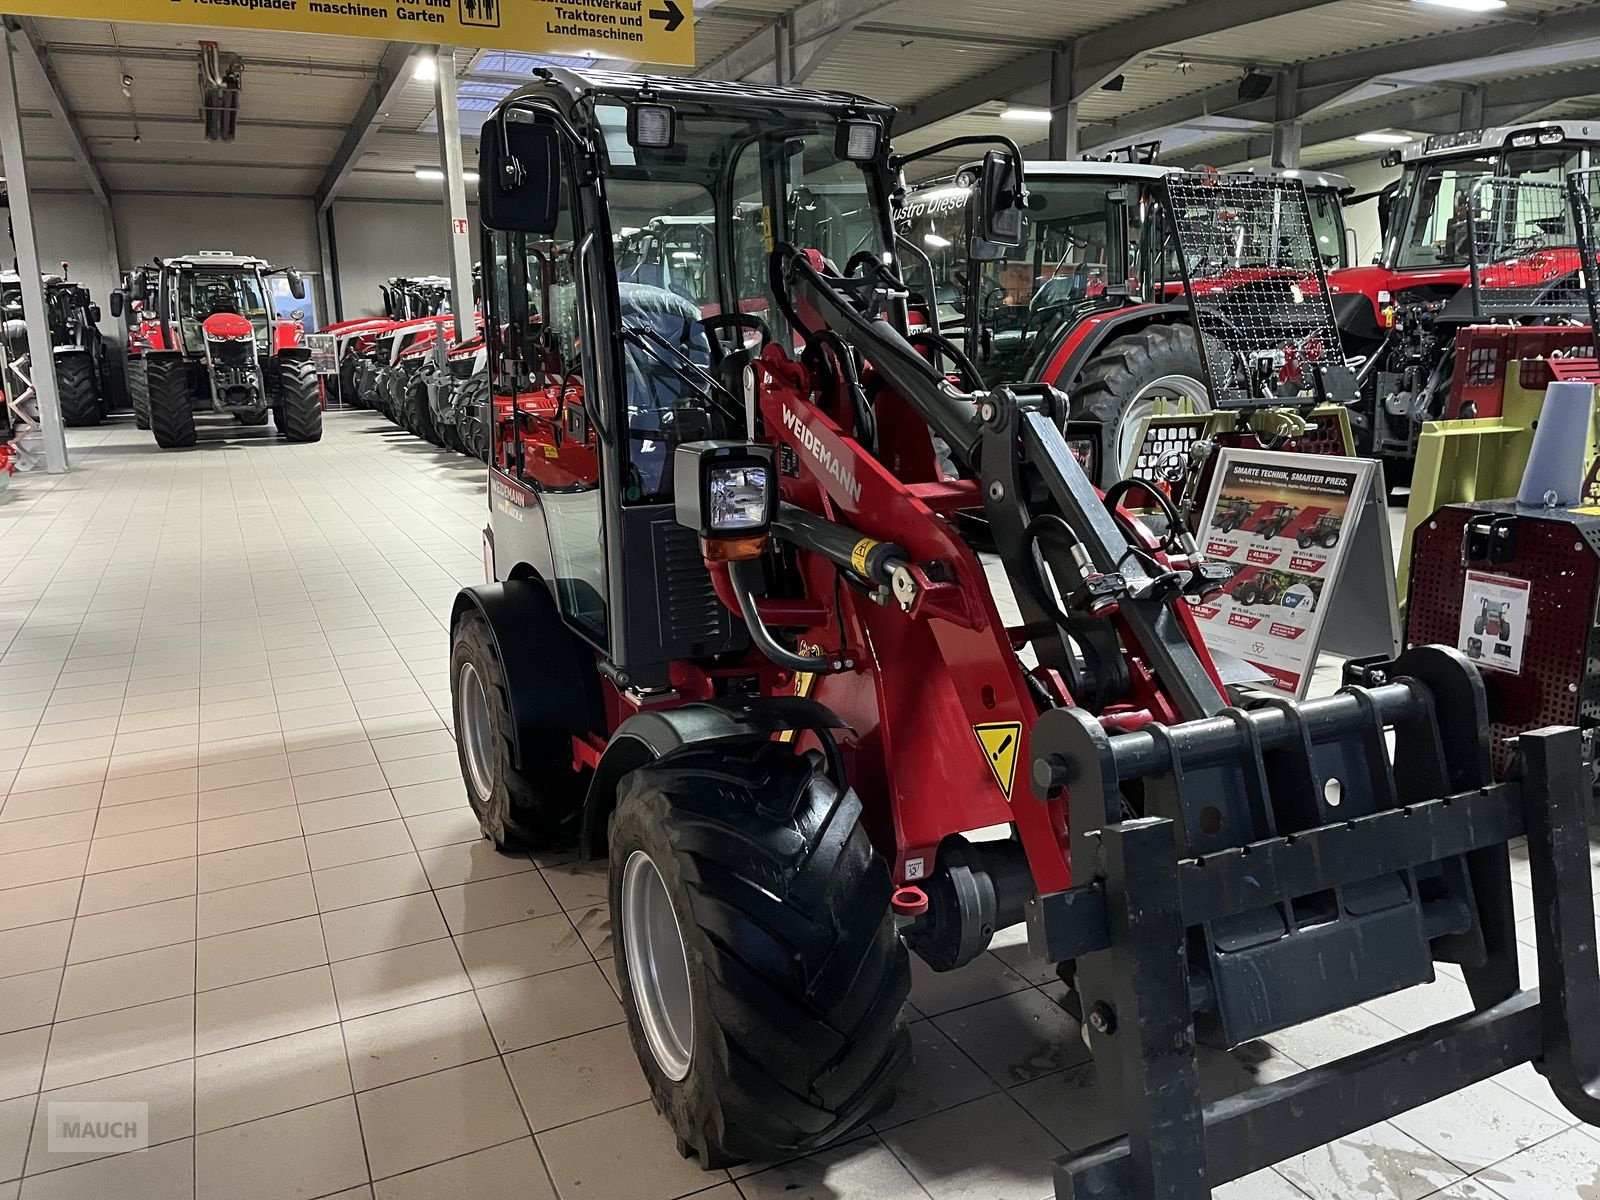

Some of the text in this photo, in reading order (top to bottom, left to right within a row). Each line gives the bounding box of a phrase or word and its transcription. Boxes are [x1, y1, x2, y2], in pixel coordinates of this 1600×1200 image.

[309, 2, 388, 18] maschinen
[396, 7, 445, 23] Garten
[555, 7, 642, 27] Traktoren und
[546, 21, 643, 42] Landmaschinen
[893, 194, 969, 220] ustro Diesel
[782, 403, 862, 503] WEIDEMANN
[1233, 466, 1348, 486] SMARTE TECHNIK, SMARTER PREIS.
